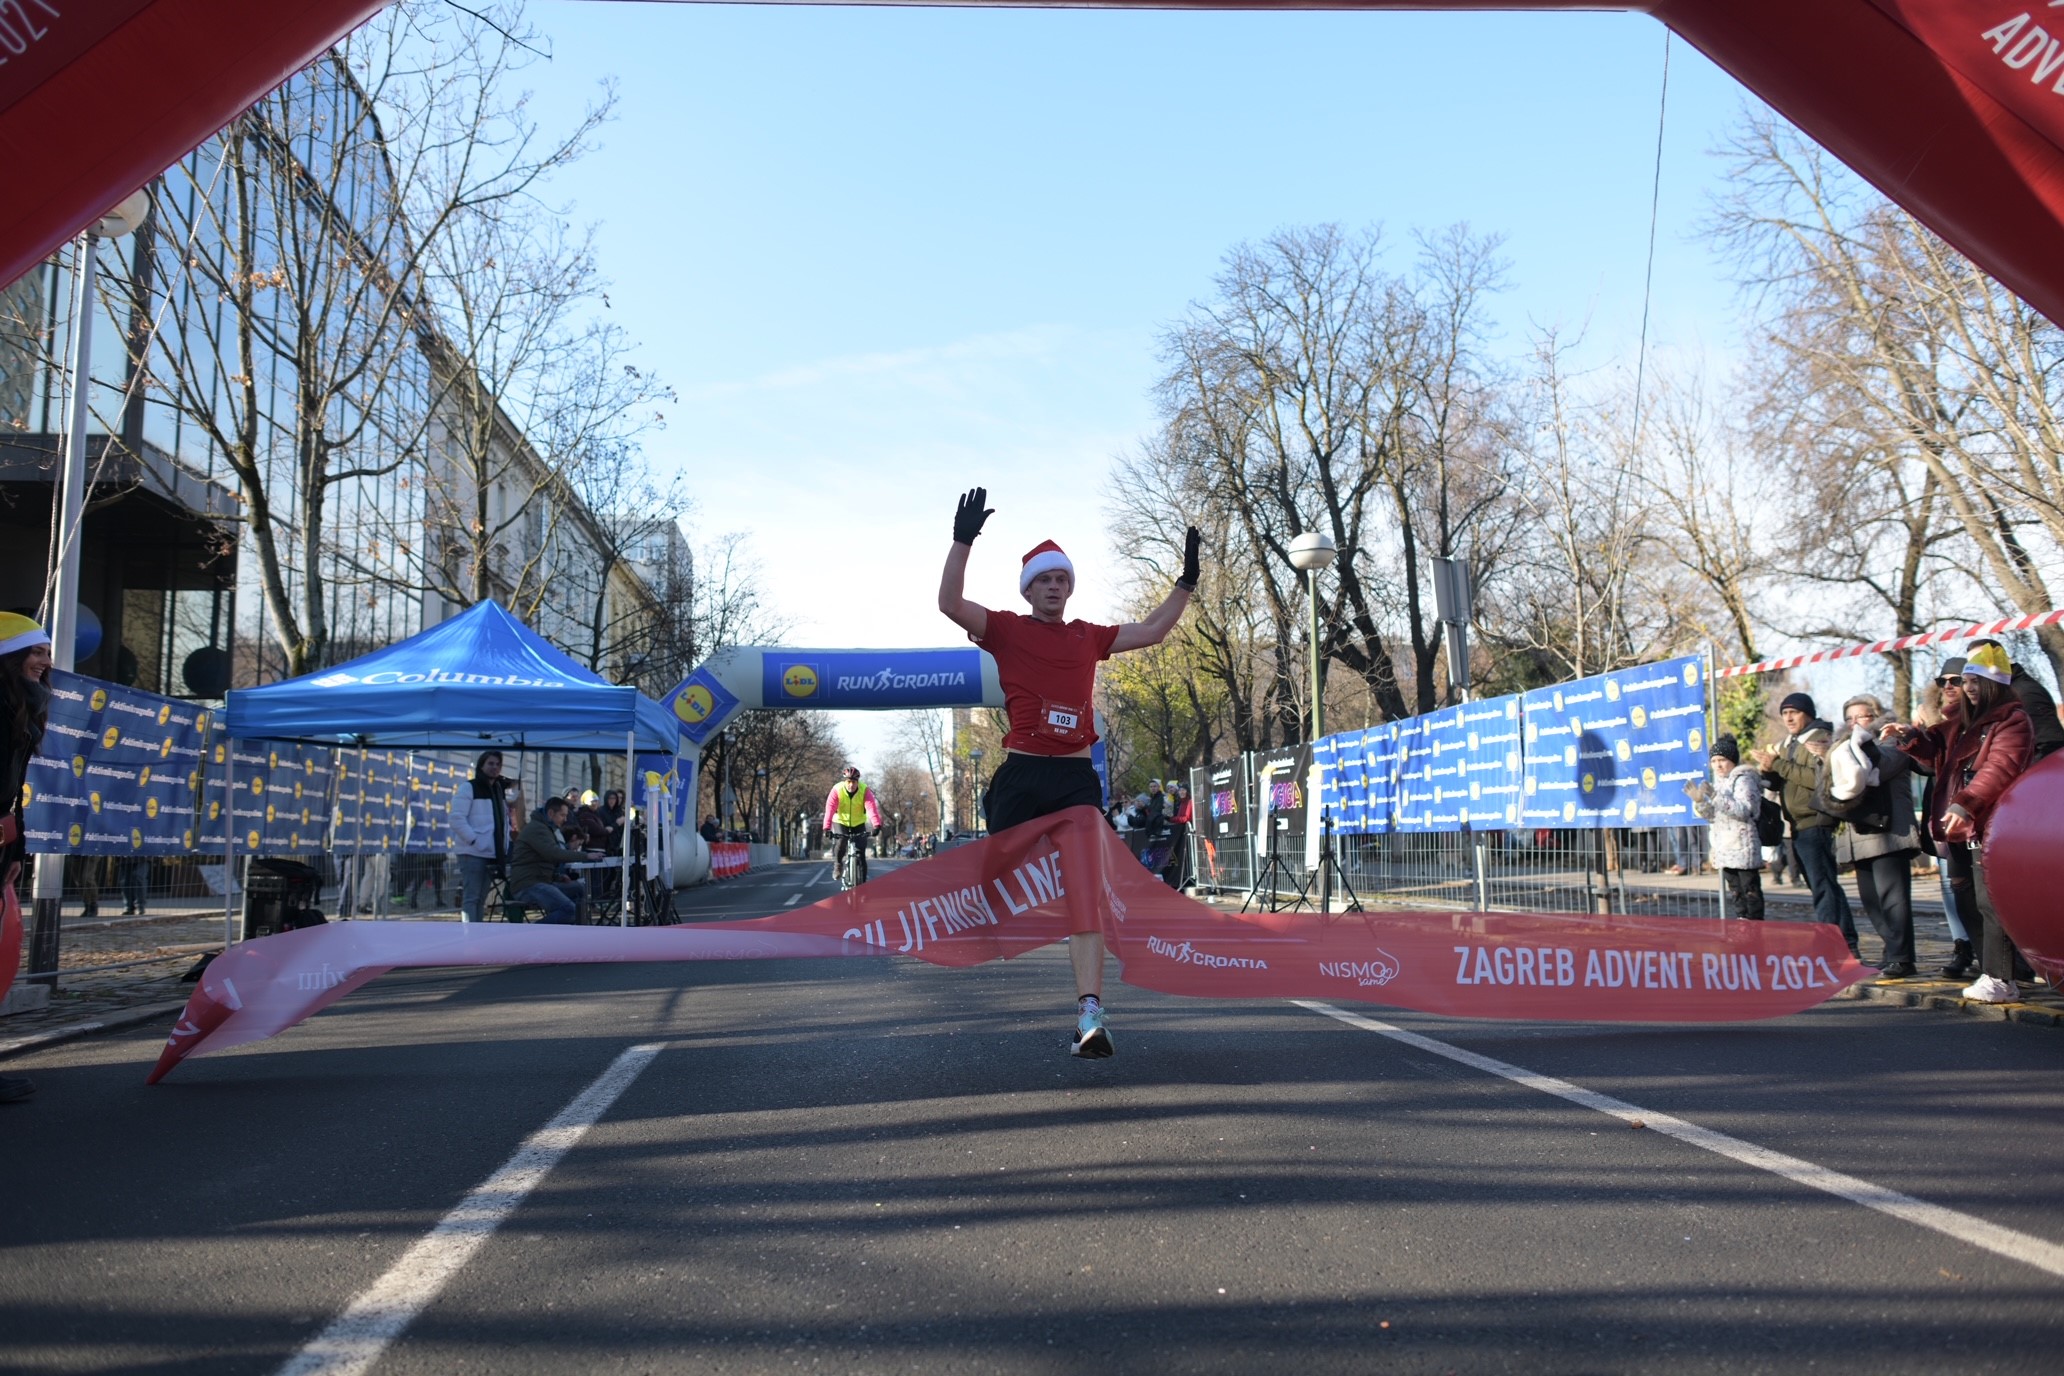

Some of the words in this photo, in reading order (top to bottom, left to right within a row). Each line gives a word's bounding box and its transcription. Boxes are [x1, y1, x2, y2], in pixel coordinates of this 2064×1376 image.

[361, 669, 564, 687] Columbia
[837, 676, 875, 691] RUN
[893, 672, 965, 688] CROATIA
[1056, 715, 1071, 725] 103
[994, 851, 1065, 916] LINE
[1147, 936, 1177, 959] RUN
[1193, 952, 1268, 969] CROATIA
[1319, 961, 1386, 978] NISMO
[1453, 946, 1575, 987] ZAGREB
[1584, 949, 1693, 989] ADVENT
[1702, 953, 1762, 991] RUN
[1766, 955, 1840, 990] 2021
